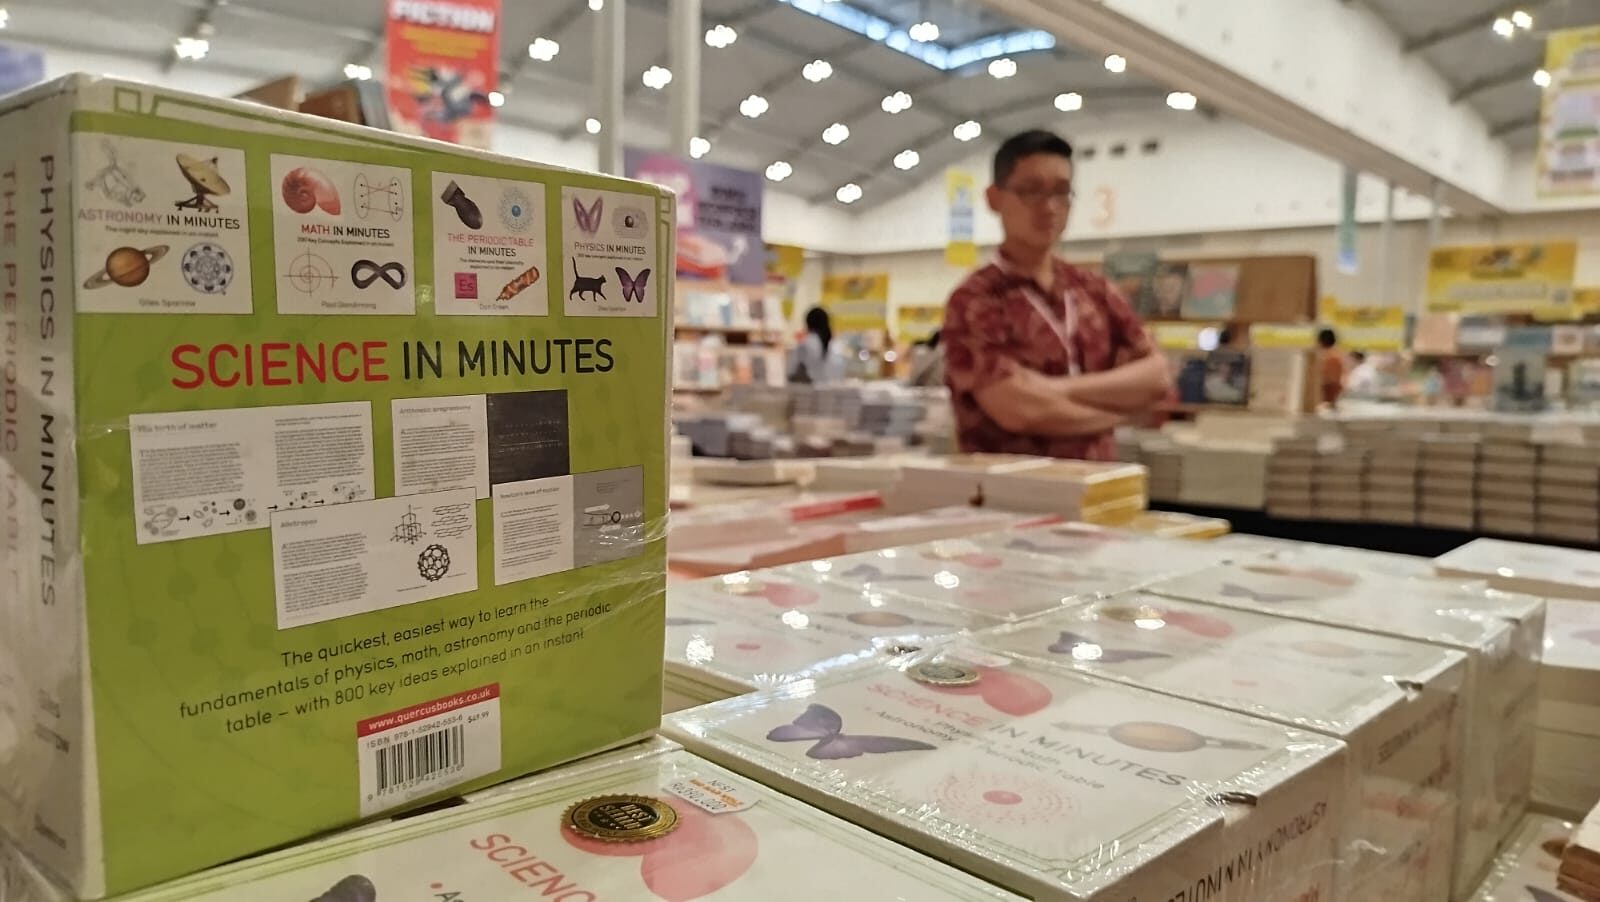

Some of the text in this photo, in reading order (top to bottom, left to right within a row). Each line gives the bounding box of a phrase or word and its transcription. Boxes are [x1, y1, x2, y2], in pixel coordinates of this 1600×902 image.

[3, 168, 17, 246] THE
[78, 208, 240, 230] ASTRONOMY IN MINUTES
[301, 224, 391, 239] MATH IN MINUTES
[448, 232, 534, 248] THE PERIODIC TABLE
[468, 246, 517, 257] IN MINUTES
[574, 242, 646, 255] PHYSICS IN MINUTES
[460, 280, 474, 292] Es
[4, 263, 18, 452] PERIODIC
[171, 338, 615, 389] SCIENCE IN MINUTES
[40, 155, 55, 605] PHYSICS IN MINUTES
[281, 596, 549, 668] The quickest, easiest way to learn the
[179, 602, 612, 719] fundamentals of physics, math, astronomy and the periodic
[226, 708, 273, 734] table
[295, 694, 330, 716] with
[335, 684, 365, 706] 800
[368, 679, 396, 699] key
[399, 667, 439, 689] ideas
[441, 645, 507, 678] explained
[510, 645, 522, 658] in
[524, 640, 541, 655] an
[543, 627, 584, 650] instant
[368, 687, 491, 731] www.quercusbooks.co.uk
[866, 682, 1187, 787] SCIENCE IN MINUTES
[875, 711, 961, 742] Astronomy
[367, 736, 390, 749] ISBN
[620, 804, 651, 823] BEST
[1238, 846, 1253, 872] IN
